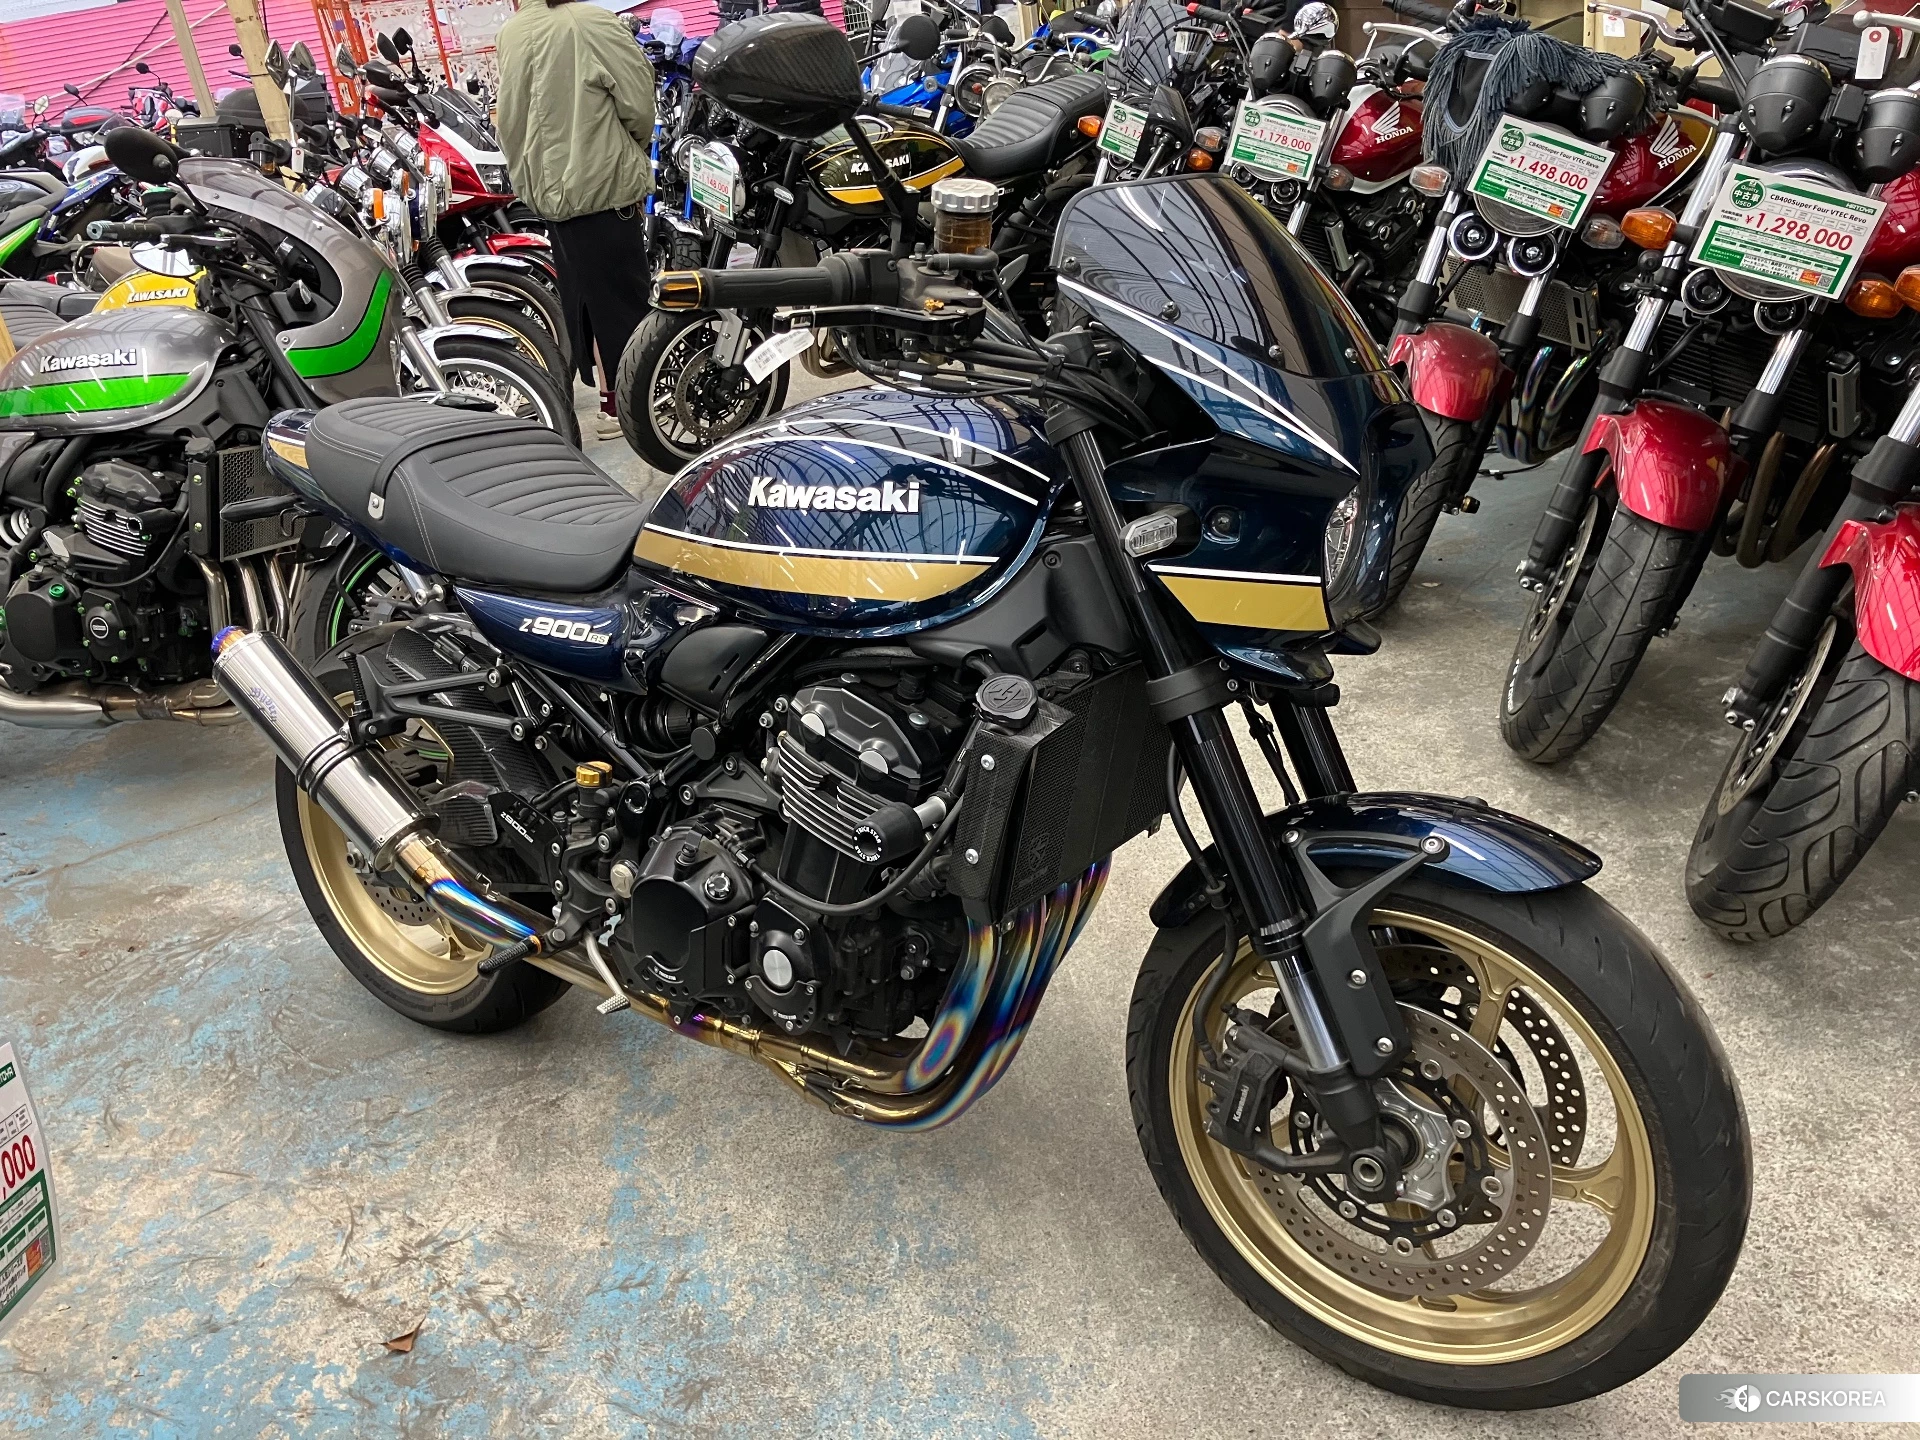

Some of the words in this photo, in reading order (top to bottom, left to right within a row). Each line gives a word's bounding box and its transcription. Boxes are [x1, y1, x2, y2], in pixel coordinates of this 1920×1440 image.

[1253, 129, 1312, 152] ¥1,178,000
[1375, 126, 1414, 144] HONDA
[851, 154, 910, 173] KASAKI
[1559, 152, 1573, 161] Four
[1572, 155, 1586, 165] VTEC
[1657, 144, 1697, 170] HONDA
[1509, 155, 1588, 190] ¥1,498,000
[1733, 189, 1760, 203] 中古車
[1740, 184, 1760, 194] Quality
[1734, 199, 1753, 209] USED
[1770, 193, 1813, 210] CB400Super
[1812, 204, 1830, 215] Four
[1830, 209, 1850, 219] VTEC
[1849, 213, 1867, 224] Revo
[1744, 212, 1853, 251] ¥1,298,000
[127, 287, 190, 304] KAWASAKI
[39, 349, 138, 373] Kawasaki
[747, 476, 920, 515] Kawasaki
[1232, 1084, 1250, 1123] Kawasaki
